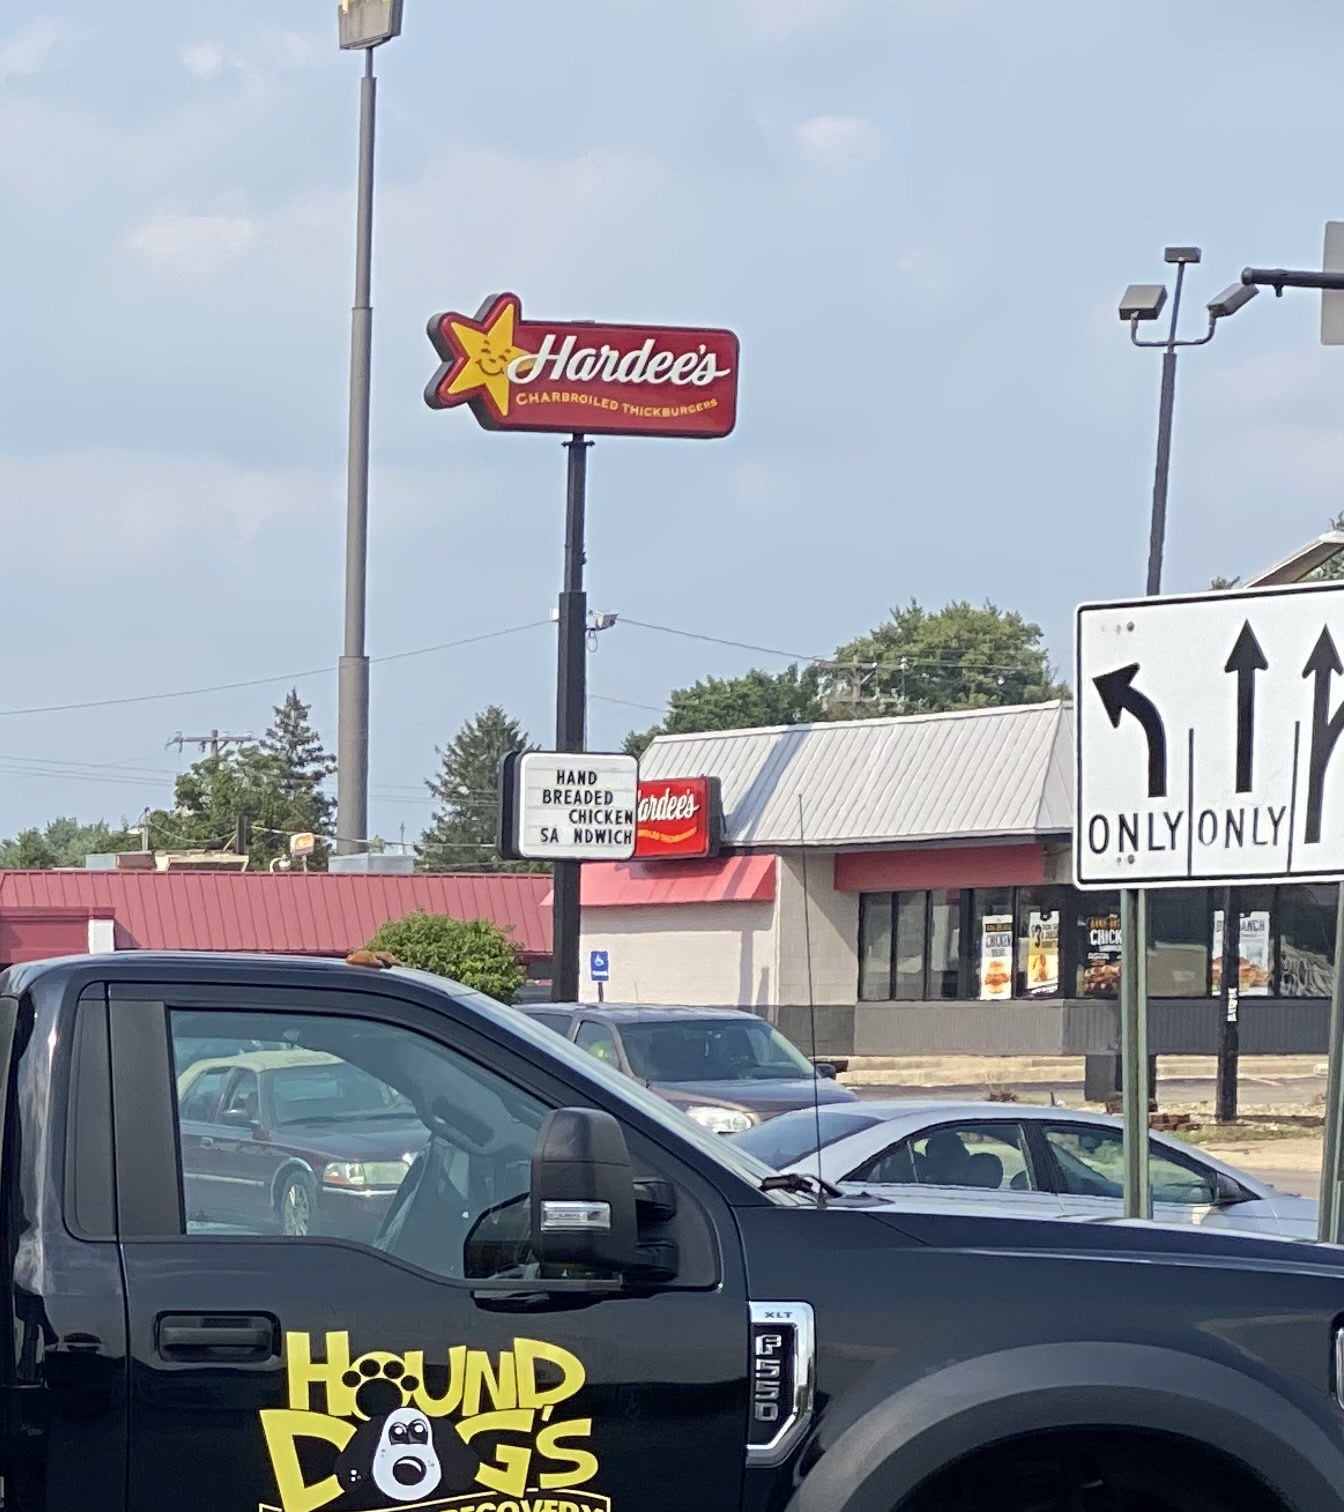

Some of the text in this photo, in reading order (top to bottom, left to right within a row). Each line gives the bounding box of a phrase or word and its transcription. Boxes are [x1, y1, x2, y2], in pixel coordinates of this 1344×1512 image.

[507, 334, 731, 386] Hardee's
[516, 392, 718, 418] CHARBROILED THICKBURGERS
[556, 769, 598, 785] HAND
[542, 789, 614, 805] BREADED
[638, 787, 700, 821] ardee's
[569, 809, 633, 825] CHICKEN
[1198, 806, 1286, 848] ONLY
[1088, 811, 1184, 854] ONLY
[1090, 929, 1122, 945] CHICK
[286, 1330, 586, 1421] HOUND
